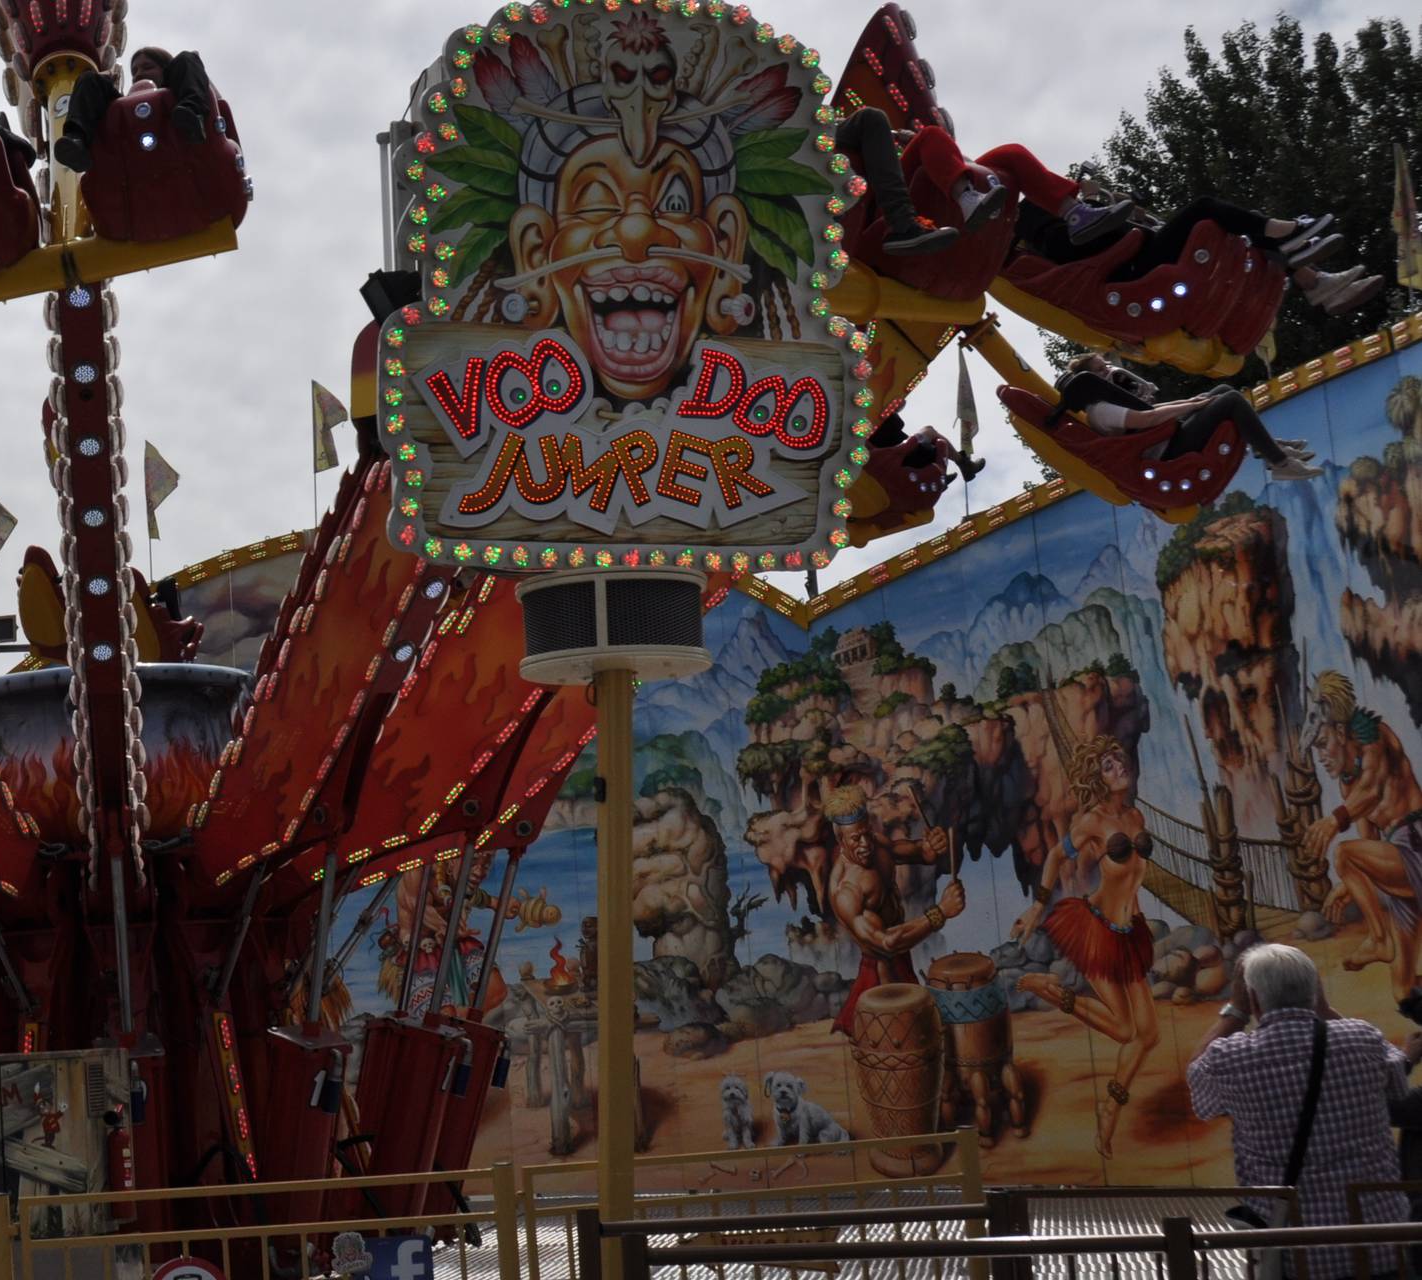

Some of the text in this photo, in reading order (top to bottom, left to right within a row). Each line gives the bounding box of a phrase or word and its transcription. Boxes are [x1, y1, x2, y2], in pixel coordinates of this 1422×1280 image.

[425, 338, 828, 449] VOO DOO
[458, 429, 775, 514] JUMPER
